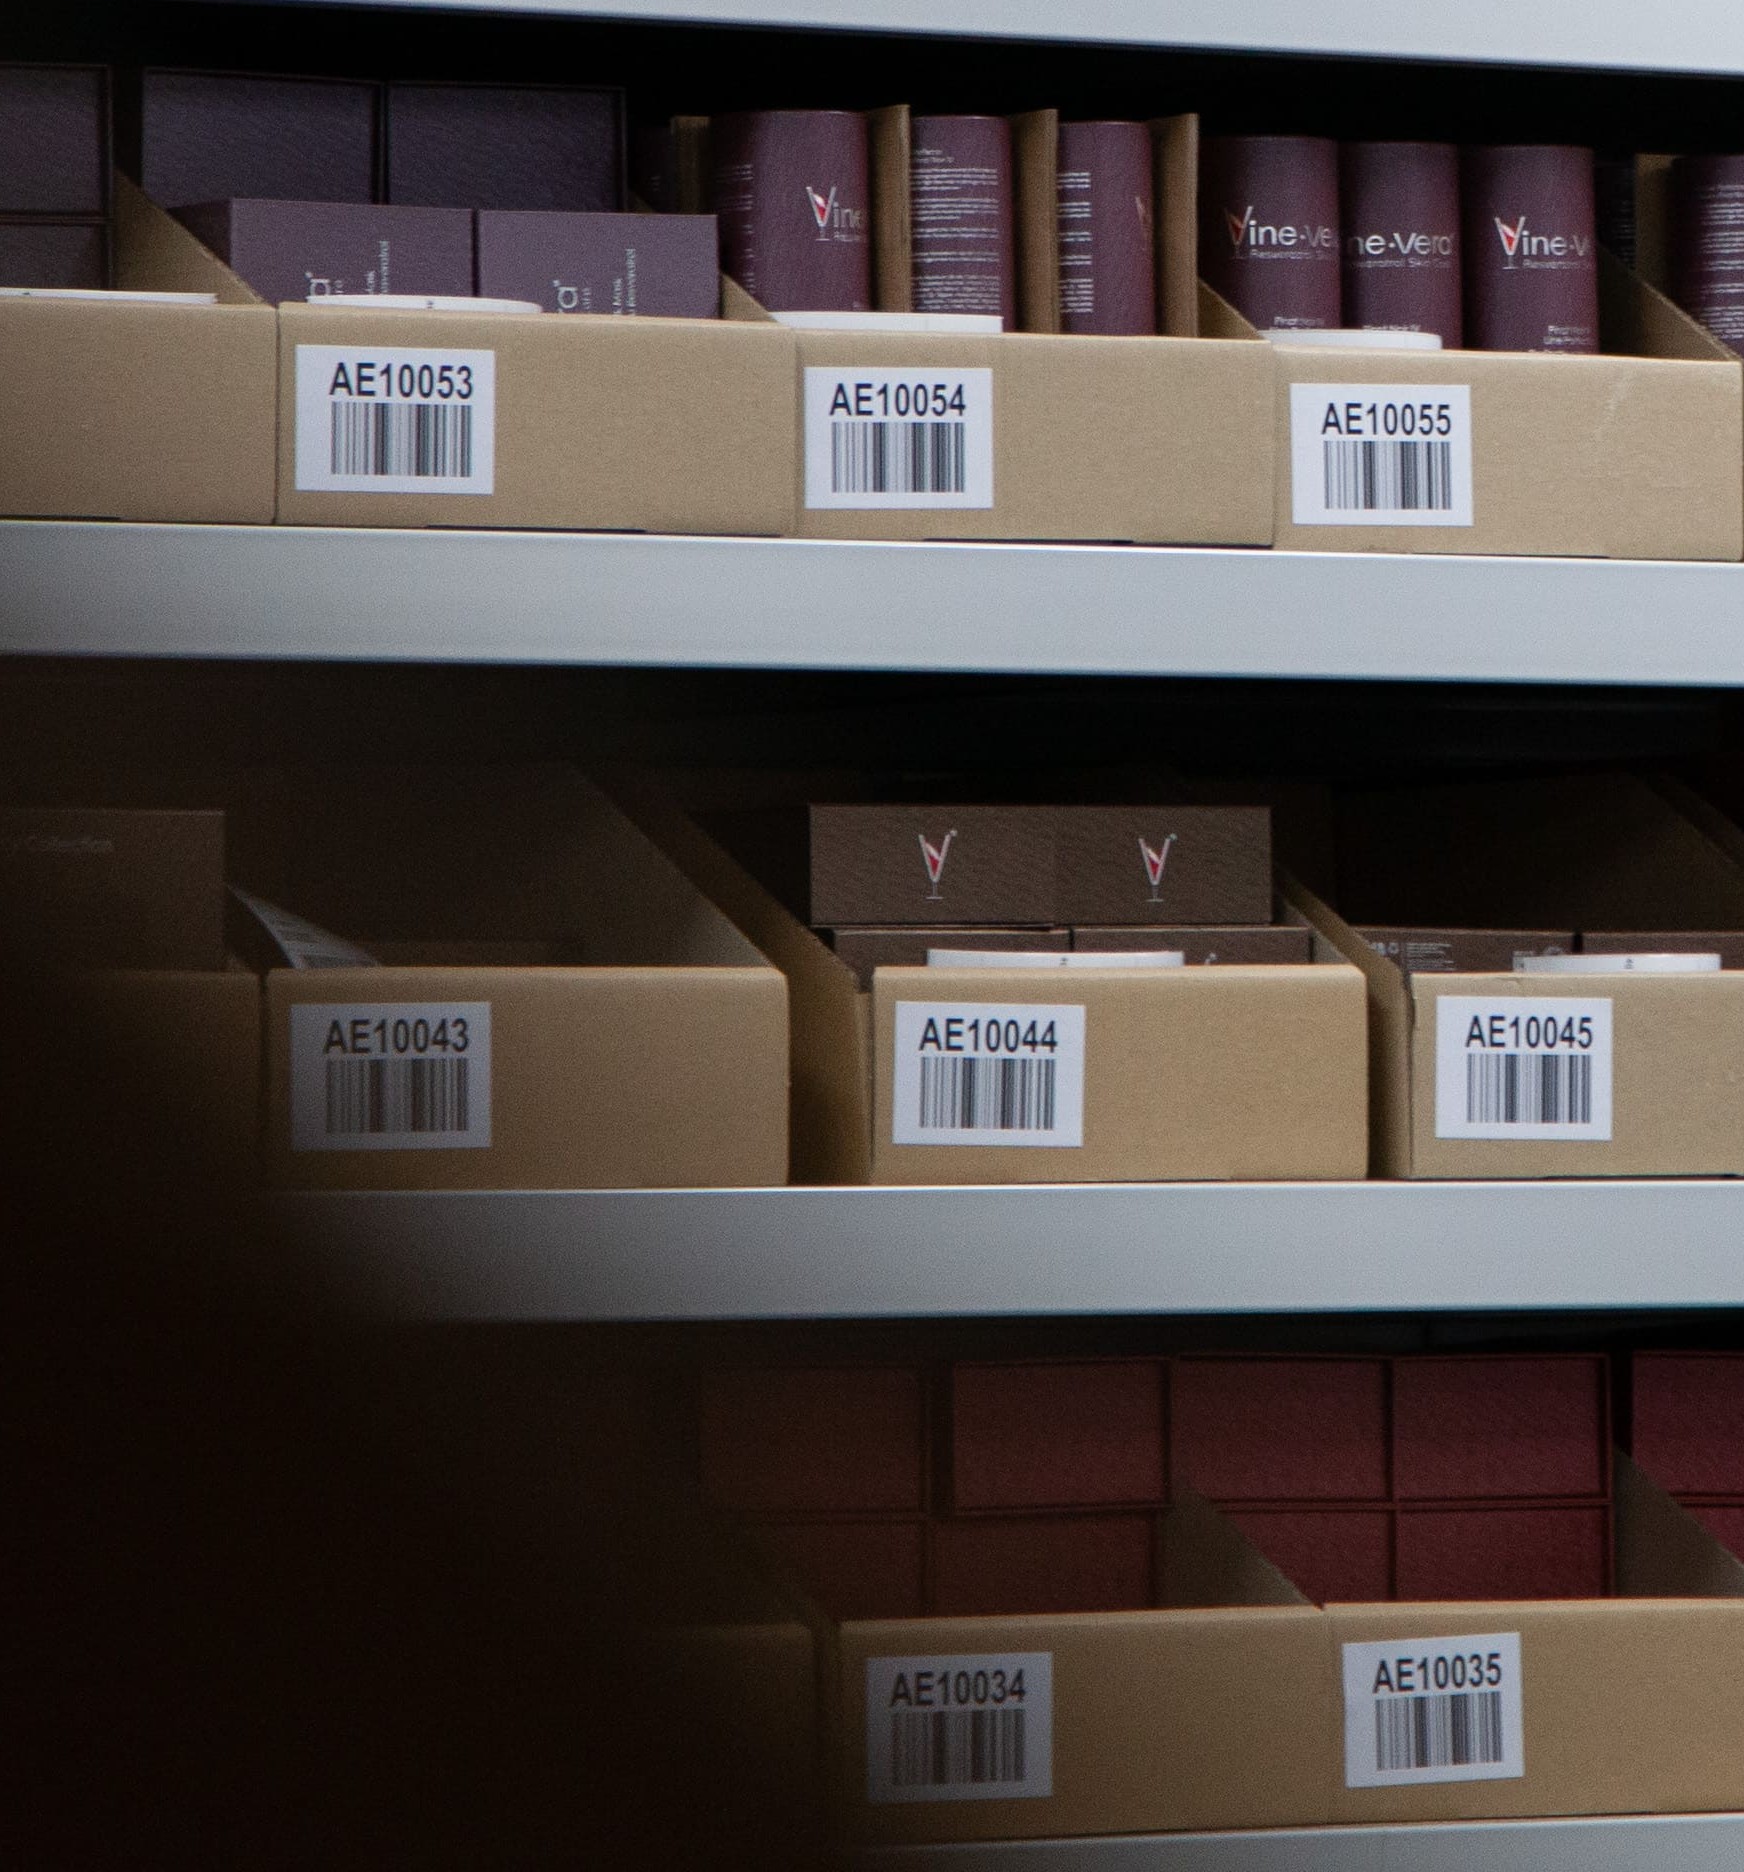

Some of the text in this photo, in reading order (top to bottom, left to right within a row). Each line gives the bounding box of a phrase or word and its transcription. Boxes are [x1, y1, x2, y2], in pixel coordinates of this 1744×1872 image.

[329, 361, 473, 400] AE10053
[829, 382, 966, 417] AE10054
[1321, 402, 1451, 436] AE10055
[324, 1019, 469, 1054] AE10043
[918, 1017, 1058, 1053] AE10044
[1465, 1015, 1593, 1050] AE10045
[889, 1670, 1026, 1706] AE10034
[1372, 1652, 1502, 1694] AE10035
